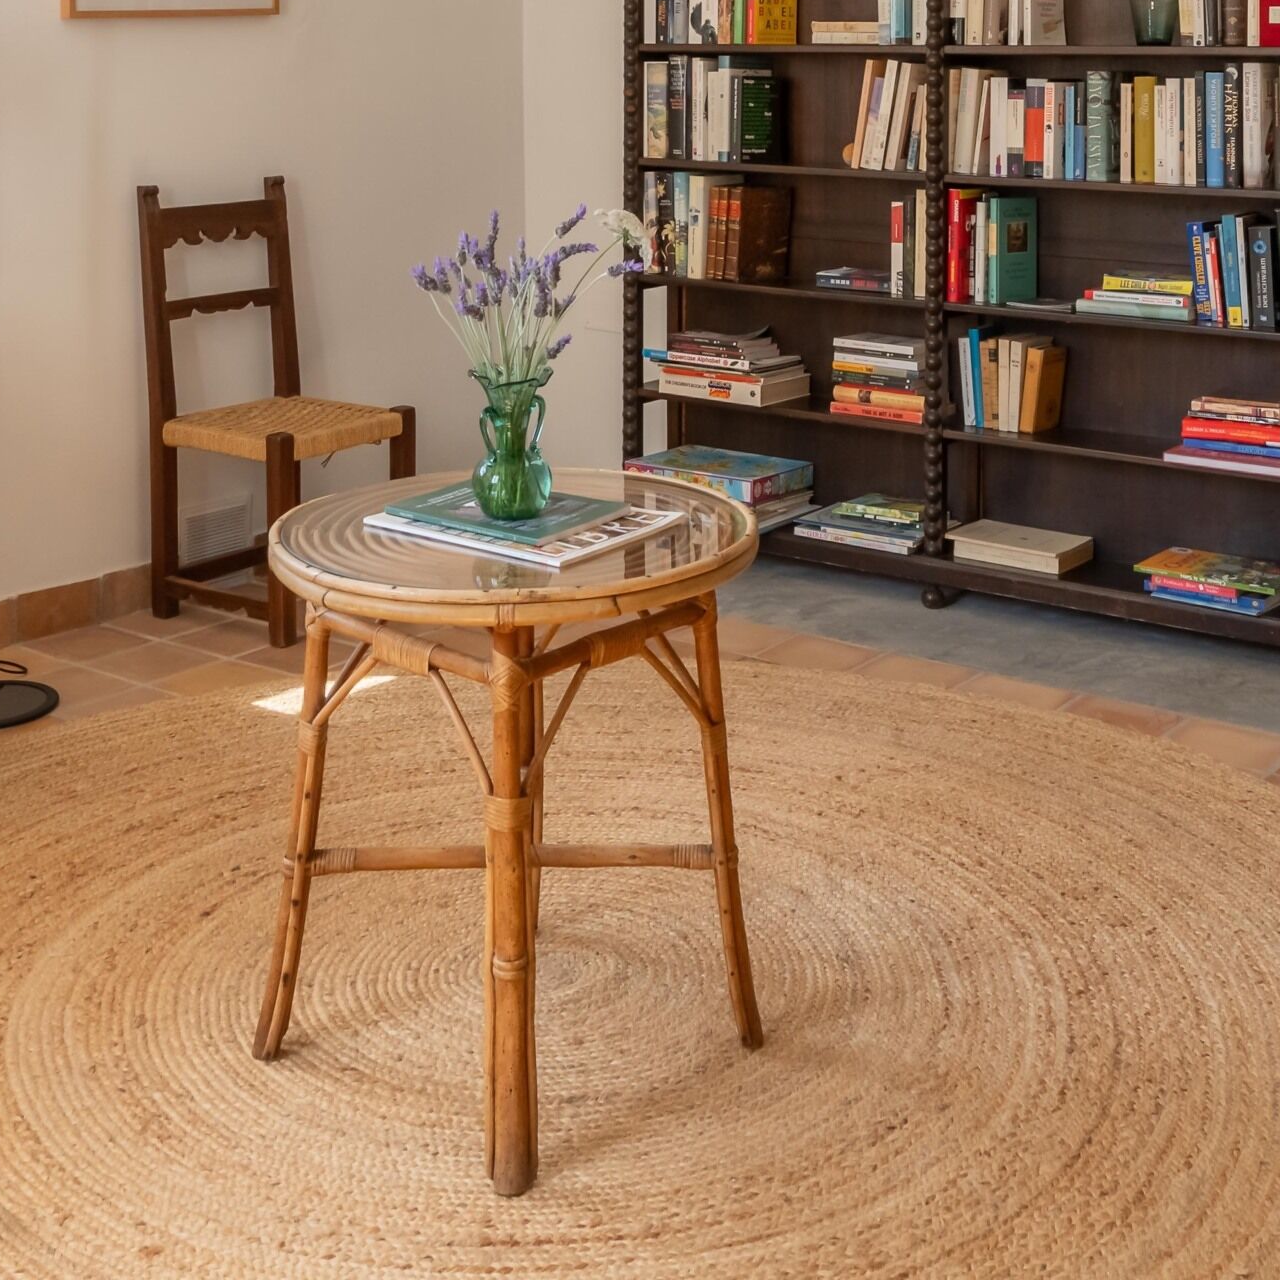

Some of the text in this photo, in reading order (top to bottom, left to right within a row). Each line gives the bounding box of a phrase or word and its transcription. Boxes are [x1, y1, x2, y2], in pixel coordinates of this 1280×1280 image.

[1224, 84, 1232, 134] HARRIS
[1192, 236, 1202, 256] CLIVE
[1194, 256, 1205, 285] CUSSLER
[1120, 280, 1147, 289] LEE CHILD
[697, 356, 721, 365] Alphabet
[526, 514, 663, 557] LIBRE
